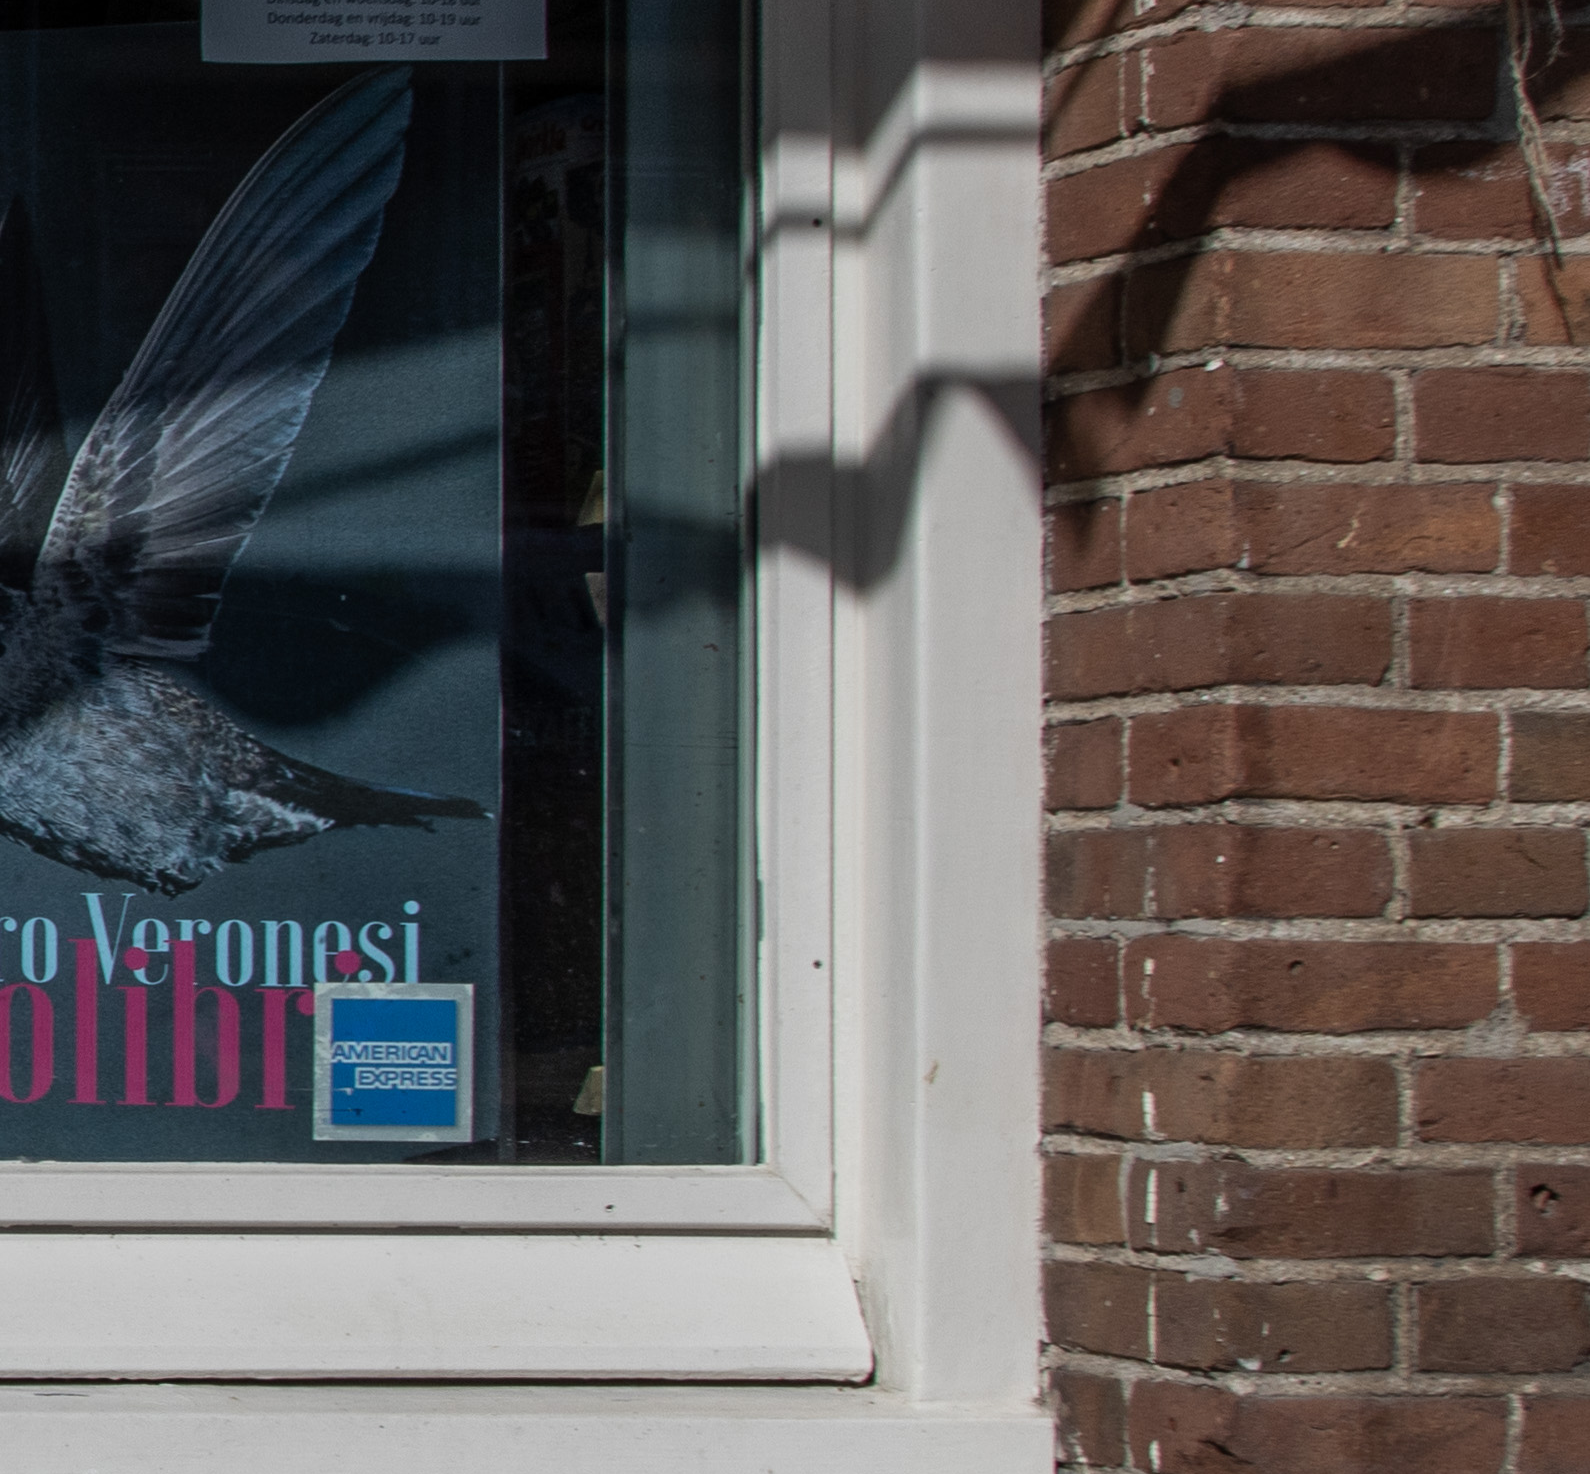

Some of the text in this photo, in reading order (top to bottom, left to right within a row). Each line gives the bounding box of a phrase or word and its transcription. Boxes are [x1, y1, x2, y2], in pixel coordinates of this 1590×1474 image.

[267, 12, 344, 27] Donderdag
[346, 15, 365, 26] en
[80, 891, 422, 987] Veronesi
[331, 1042, 450, 1063] AMERICAN
[356, 1068, 457, 1088] EXPRESS
